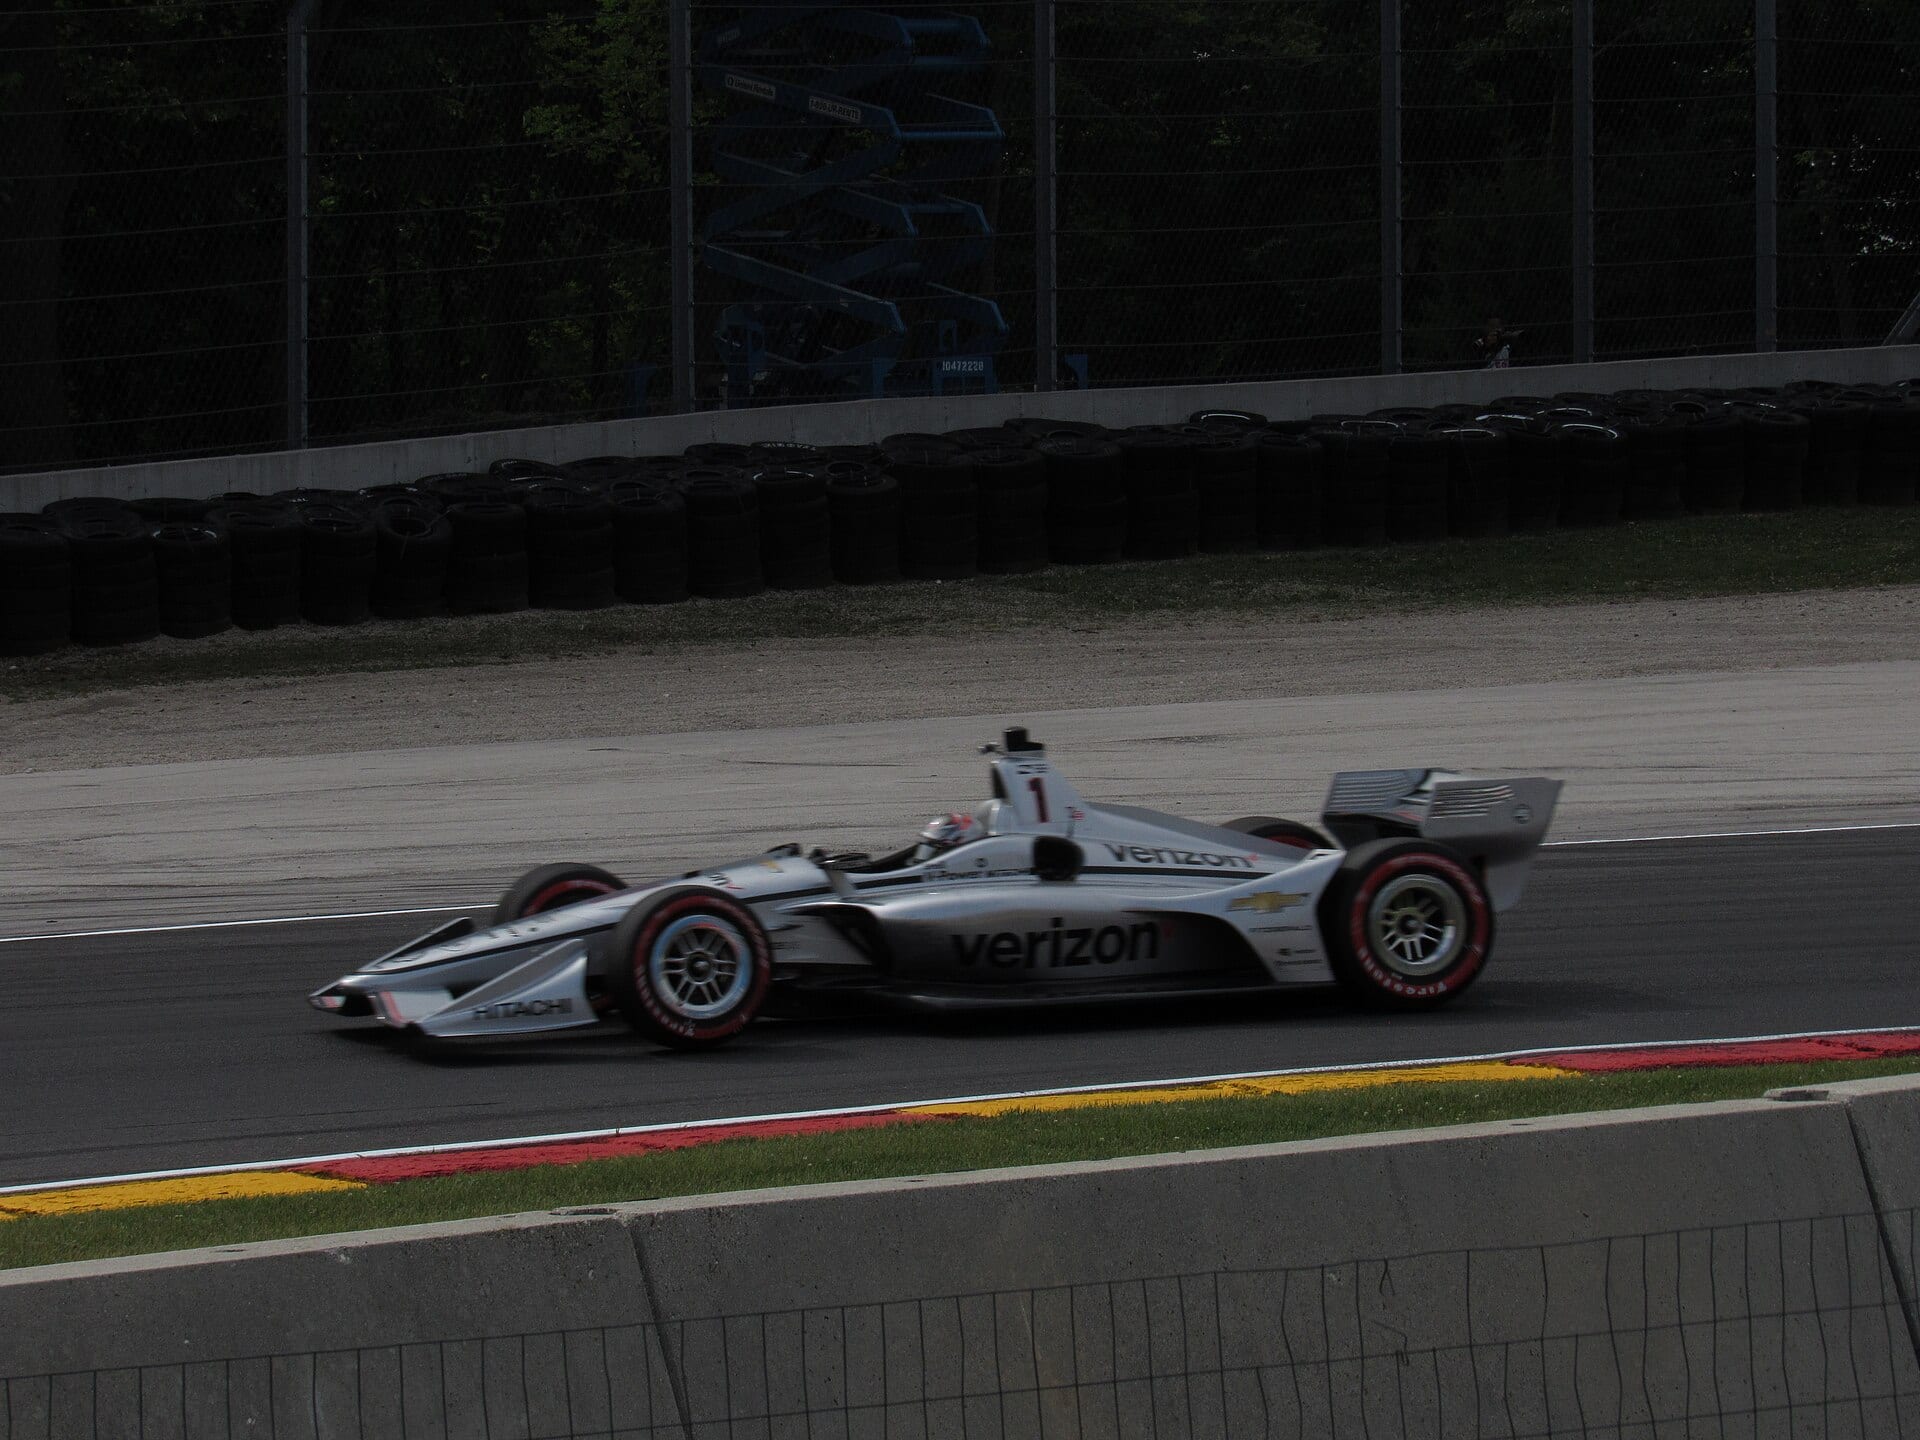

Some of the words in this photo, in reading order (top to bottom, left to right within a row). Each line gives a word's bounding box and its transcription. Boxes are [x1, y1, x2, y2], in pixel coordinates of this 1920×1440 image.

[1028, 777, 1050, 823] 1
[1104, 843, 1253, 868] verizon
[951, 917, 1159, 968] verizon
[472, 998, 573, 1020] HITACHI
